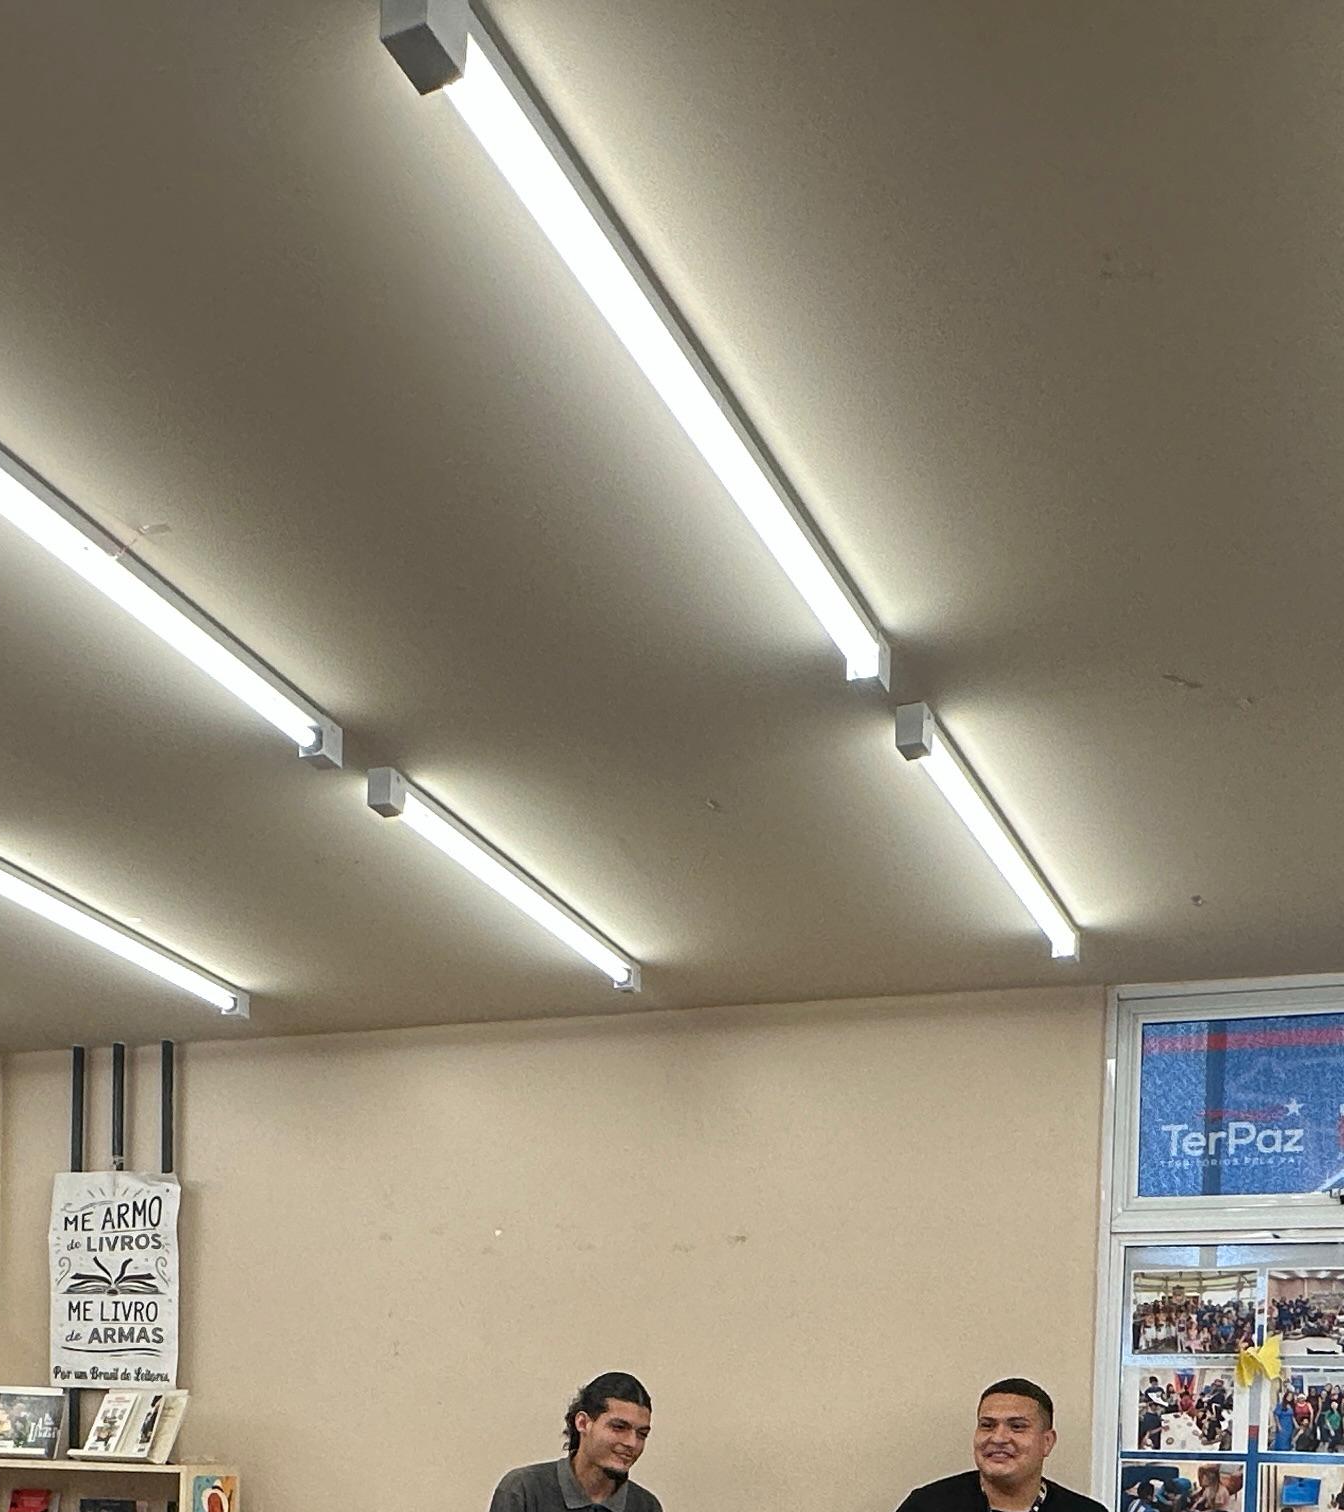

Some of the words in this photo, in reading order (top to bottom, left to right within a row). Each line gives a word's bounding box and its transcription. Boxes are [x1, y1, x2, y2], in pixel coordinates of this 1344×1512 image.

[1161, 1121, 1304, 1157] TerPaz
[64, 1211, 94, 1232] ME
[101, 1195, 163, 1231] ARMO
[66, 1239, 82, 1252] de
[68, 1300, 94, 1322] ME
[100, 1300, 159, 1322] LIVRO
[65, 1330, 82, 1342] de
[88, 1326, 165, 1345] ARMAS
[53, 1365, 72, 1380] Por
[90, 1366, 119, 1381] Brasil
[120, 1369, 131, 1381] de
